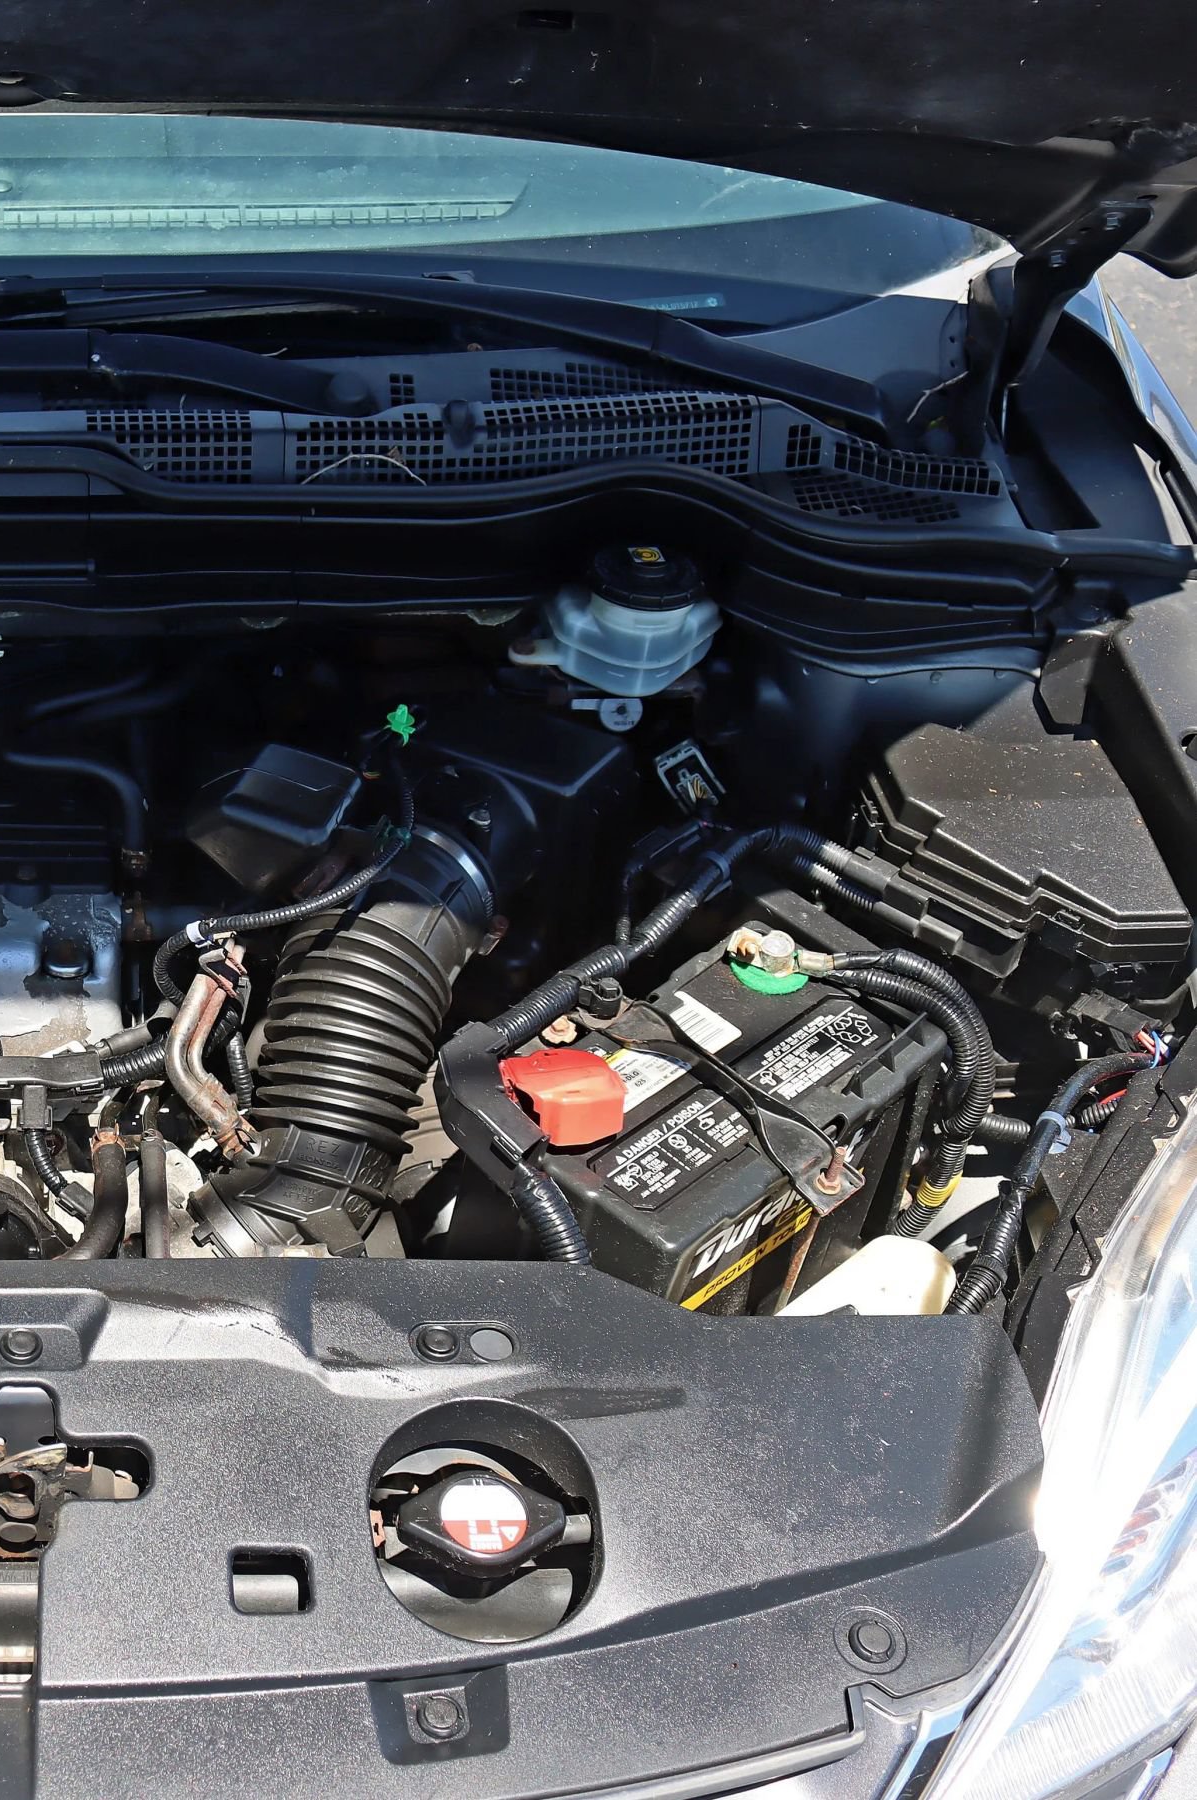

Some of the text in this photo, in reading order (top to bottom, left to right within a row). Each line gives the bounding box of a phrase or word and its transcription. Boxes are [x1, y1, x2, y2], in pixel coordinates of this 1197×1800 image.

[306, 1137, 341, 1158] REZ
[622, 1127, 666, 1159] DANGER
[666, 1101, 704, 1128] POISON
[640, 1151, 659, 1165] SHIELD
[693, 1188, 803, 1279] Dural
[704, 1244, 767, 1298] PROVEN
